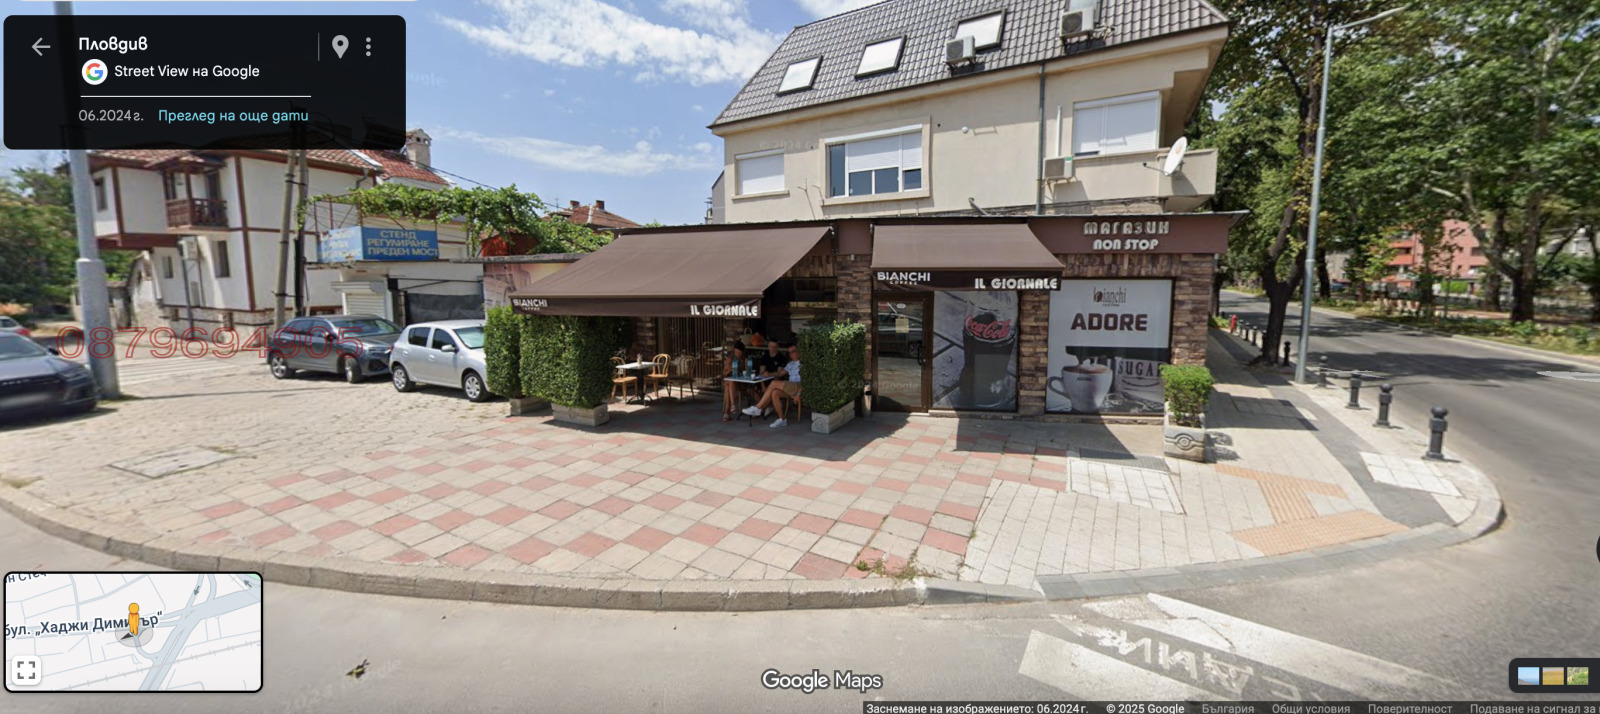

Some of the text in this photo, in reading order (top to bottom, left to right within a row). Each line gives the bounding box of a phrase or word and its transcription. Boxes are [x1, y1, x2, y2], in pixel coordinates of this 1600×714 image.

[1084, 221, 1170, 235] МАГАЗИН
[380, 231, 417, 240] СТЕНД
[367, 238, 429, 248] РЕГУЛИРАНЕ
[1124, 239, 1159, 251] STOP
[368, 247, 410, 256] ПРЕДЕН
[412, 247, 439, 256] МОСТ
[877, 271, 931, 282] BIANCHI
[974, 278, 1057, 290] IL GIORNALE
[512, 298, 549, 308] BIANCHI
[690, 304, 758, 317] IL GIORNALE
[1070, 312, 1148, 332] ADORE
